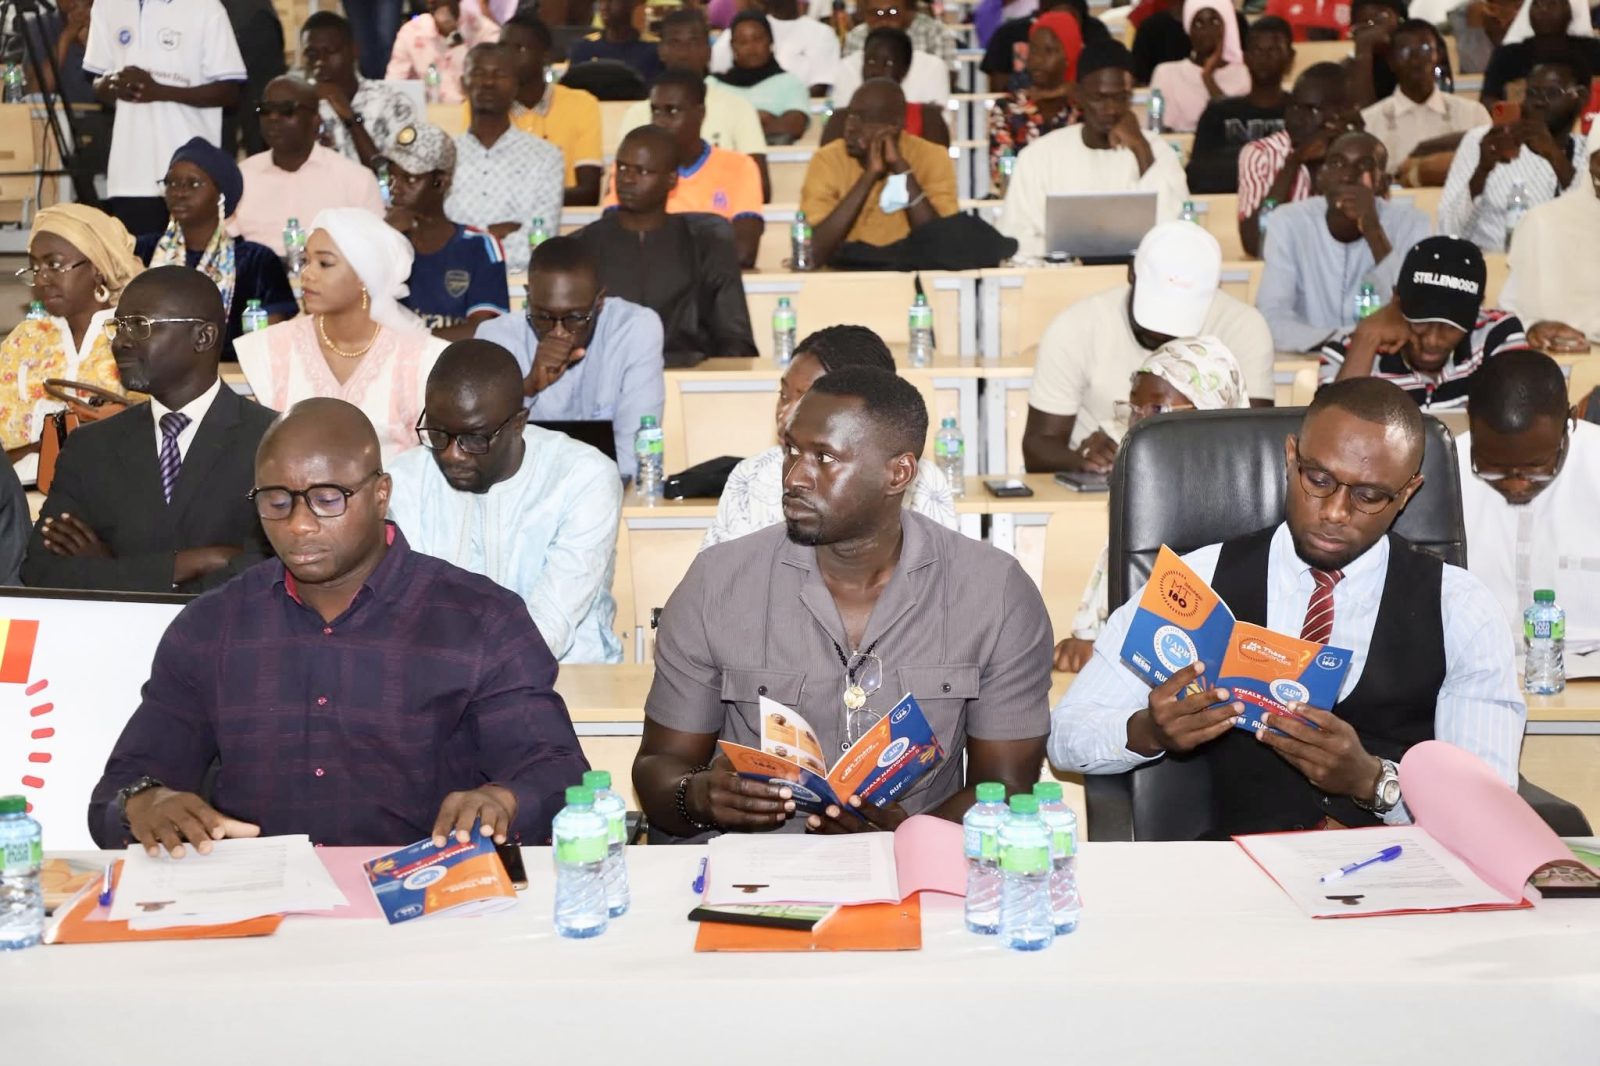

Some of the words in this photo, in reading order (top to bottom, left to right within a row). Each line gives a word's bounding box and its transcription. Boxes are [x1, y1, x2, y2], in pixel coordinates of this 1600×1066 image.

[1413, 271, 1479, 295] STELLENBOSCH
[1234, 687, 1262, 699] FINALE
[889, 781, 903, 796] AUF
